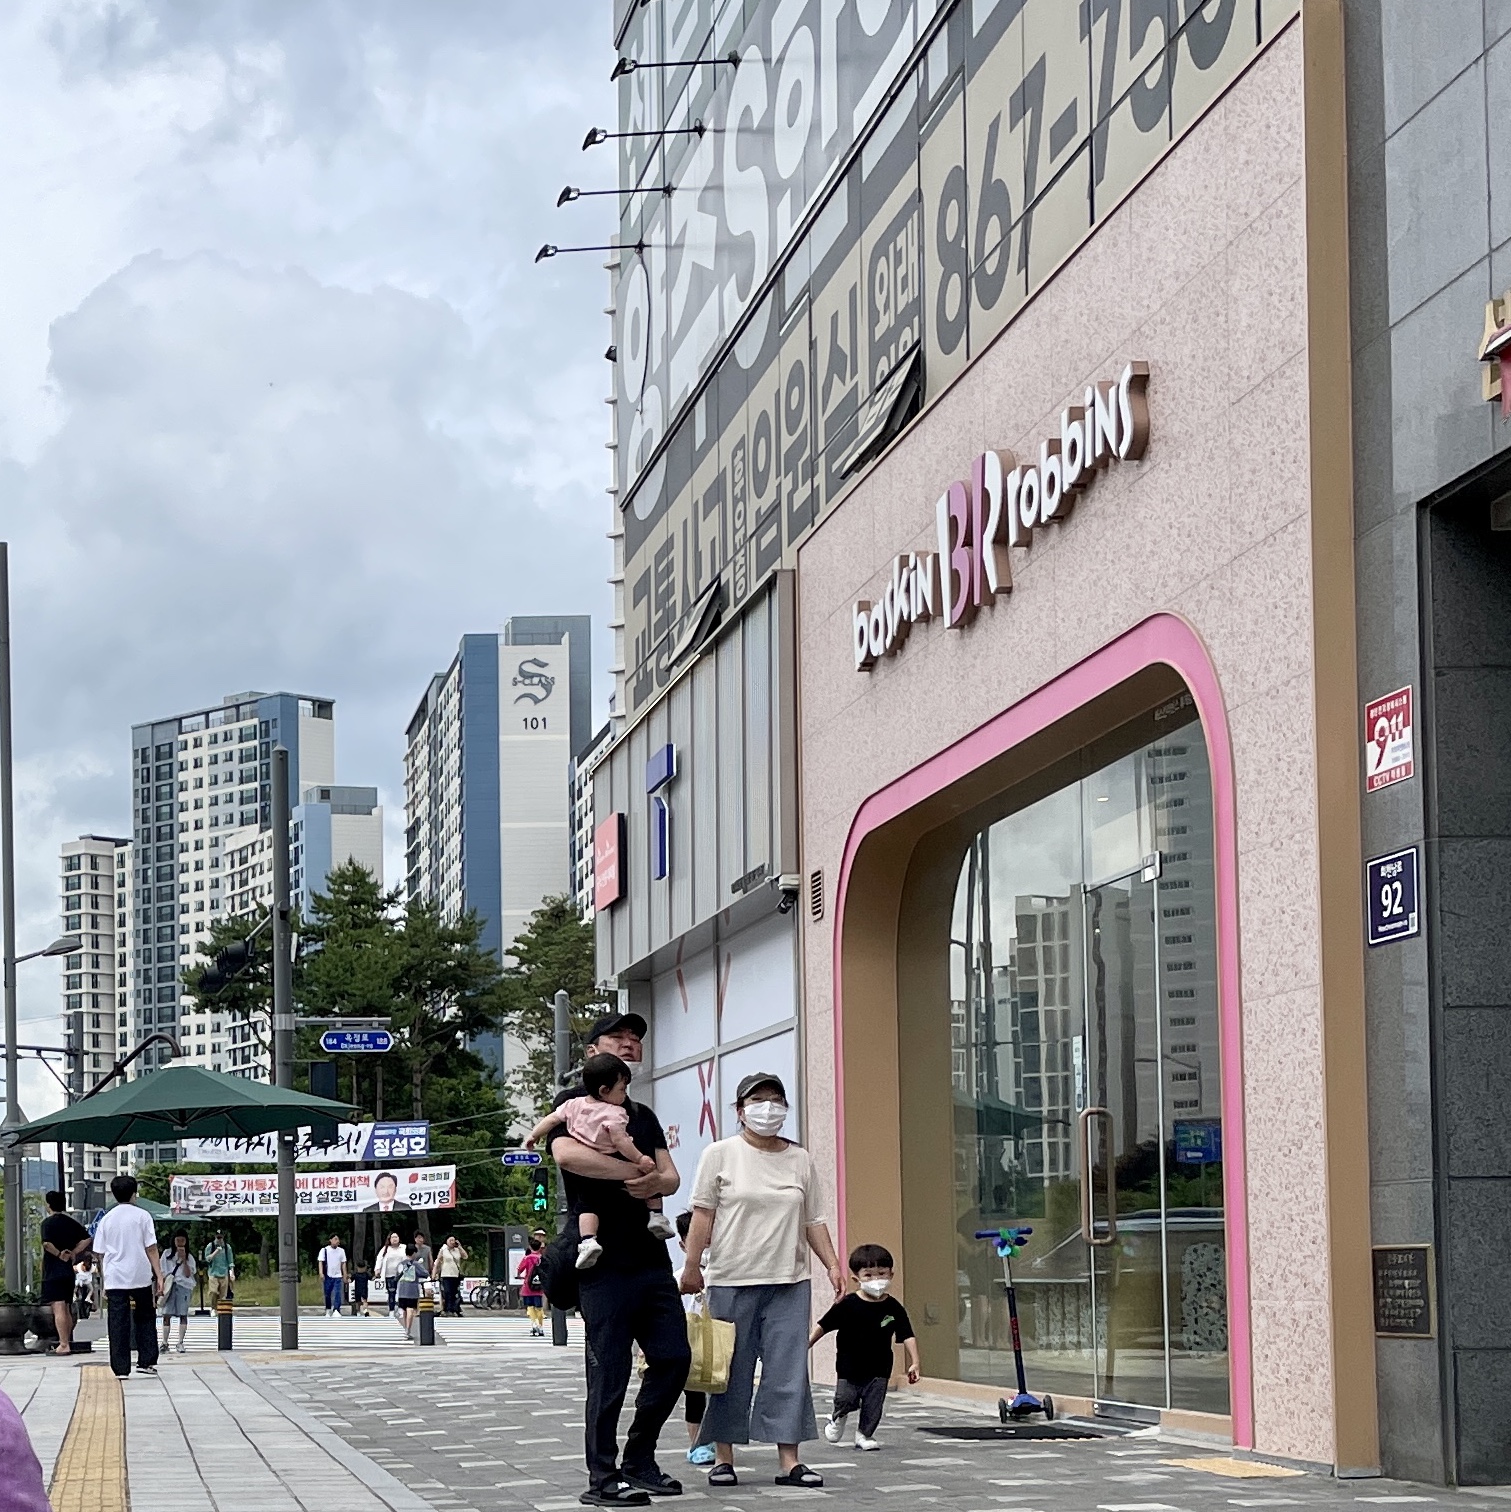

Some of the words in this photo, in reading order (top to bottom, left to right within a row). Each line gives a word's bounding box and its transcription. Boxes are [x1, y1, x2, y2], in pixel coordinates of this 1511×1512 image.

[874, 209, 918, 343] 외래
[633, 471, 731, 711] 교통사고
[752, 279, 859, 584] 입원실
[852, 550, 934, 669] baskin
[1007, 362, 1145, 547] robbins
[512, 676, 556, 687] S-CLASS
[522, 717, 547, 731] 101
[1374, 710, 1404, 770] 911
[1381, 880, 1404, 918] 92
[345, 1033, 369, 1043] 옥정로
[373, 1136, 427, 1157] 정성호
[202, 1179, 237, 1192] 7호선
[312, 1177, 339, 1190] 대한
[343, 1175, 370, 1188] 대책
[214, 1192, 255, 1206] 양주시
[316, 1189, 357, 1203] 설명회
[409, 1190, 450, 1206] 안기영
